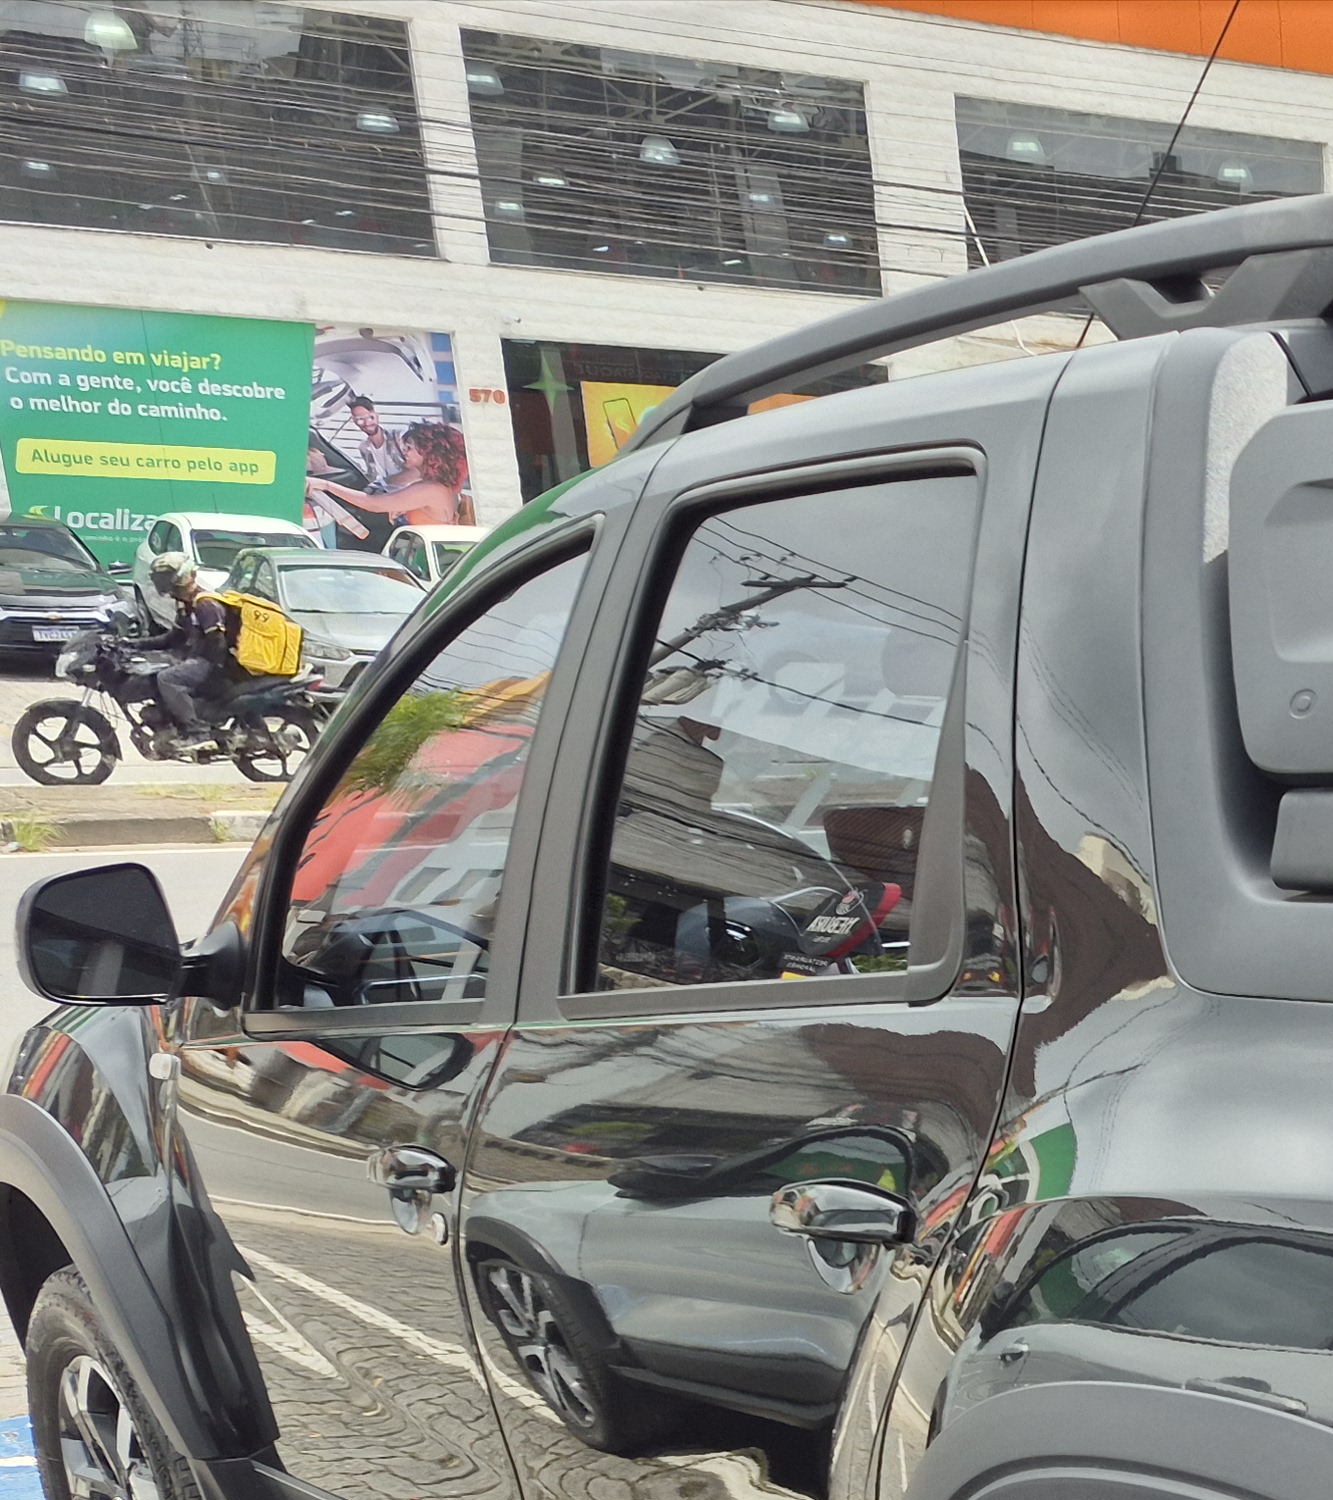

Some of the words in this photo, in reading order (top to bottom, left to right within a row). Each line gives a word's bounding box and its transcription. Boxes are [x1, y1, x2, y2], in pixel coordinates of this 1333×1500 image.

[0, 339, 107, 363] Pensando
[112, 350, 146, 366] em
[150, 349, 222, 373] viajar?
[5, 366, 52, 385] Com
[58, 373, 71, 386] a
[76, 374, 142, 394] gente,
[146, 376, 192, 394] você
[198, 378, 286, 399] descobre
[10, 396, 24, 410] o
[29, 394, 102, 414] melhor
[107, 397, 132, 416] do
[137, 402, 228, 421] caminho.
[468, 388, 506, 405] 570
[31, 448, 94, 468] Alugue
[99, 455, 130, 467] seu
[136, 455, 181, 469] carro
[187, 456, 223, 473] pelo
[229, 460, 259, 474] app
[253, 609, 270, 623] 99
